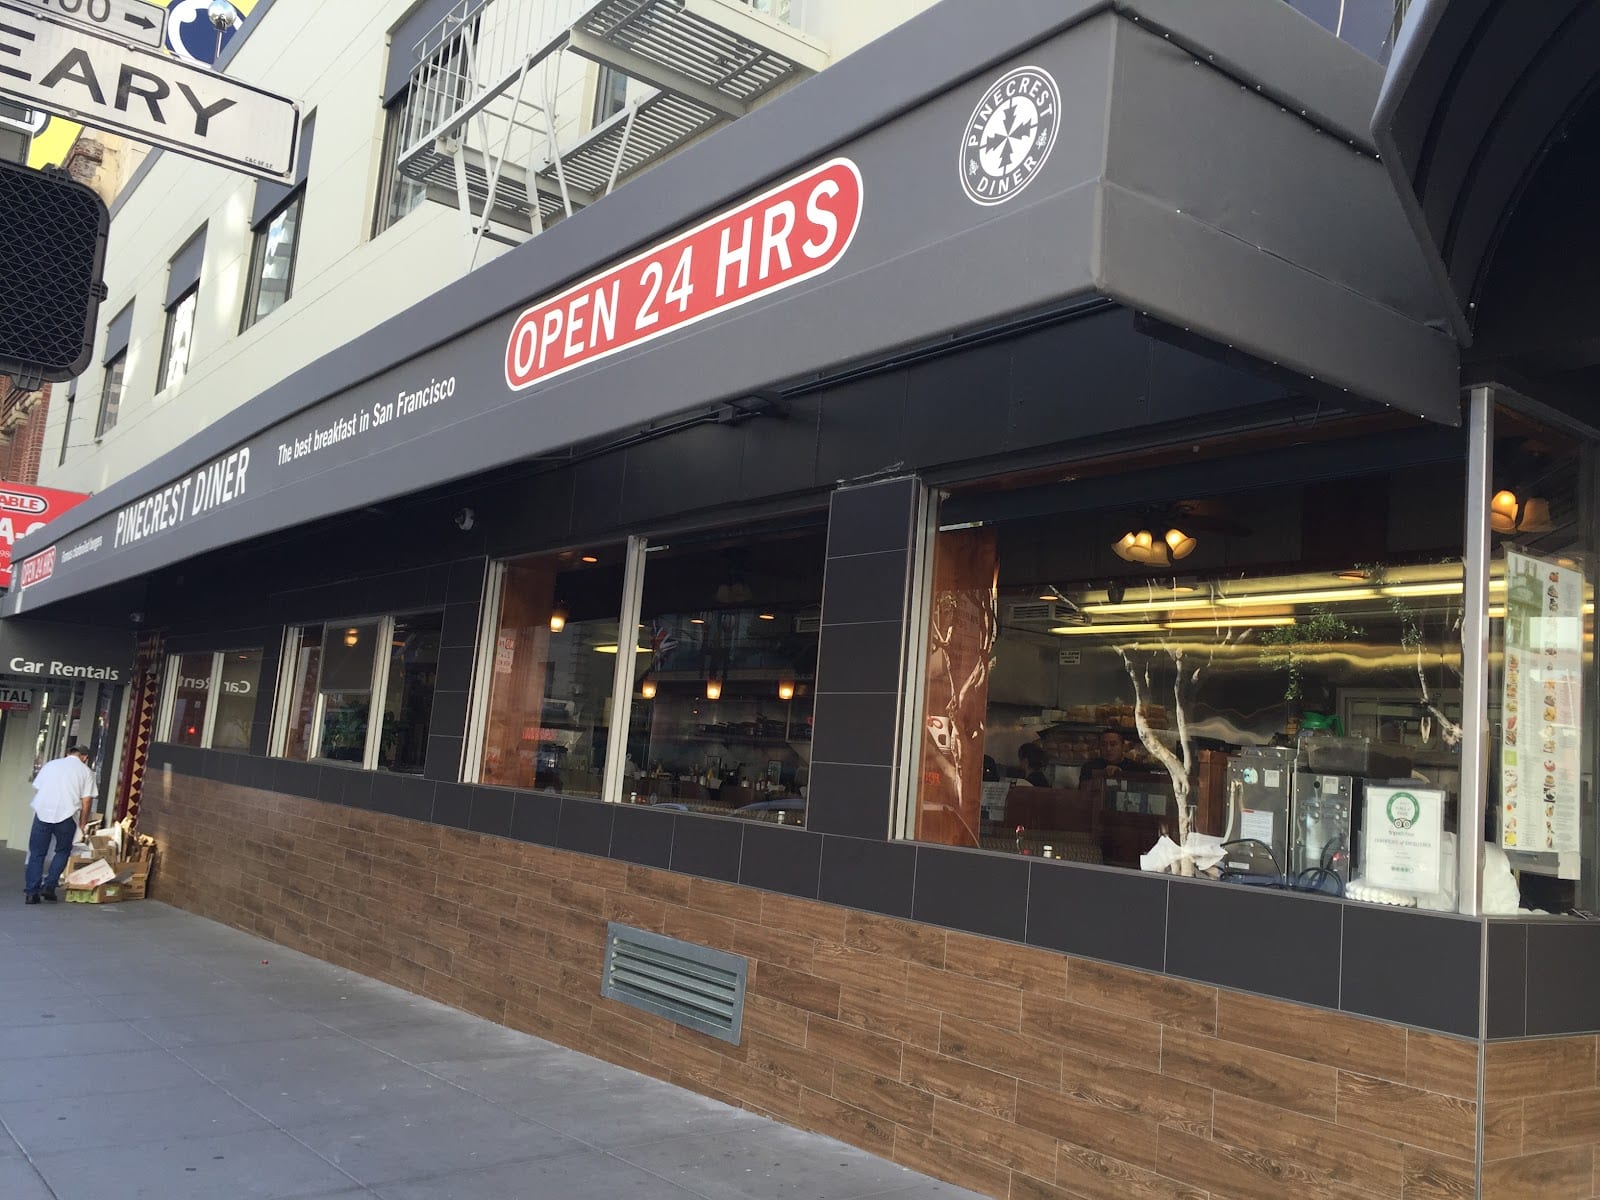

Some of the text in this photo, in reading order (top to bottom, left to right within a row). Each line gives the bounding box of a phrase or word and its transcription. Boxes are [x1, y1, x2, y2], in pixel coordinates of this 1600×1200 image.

[968, 77, 1053, 147] PINECREST
[976, 155, 1037, 196] DINER
[513, 179, 840, 378] OPEN 24 HRS
[278, 376, 456, 466] The best breakfast in San Francisco
[113, 447, 250, 549] PINECREST DINER
[22, 561, 36, 584] OPEN
[0, 689, 28, 702] TAL
[9, 657, 119, 681] Car Rentals
